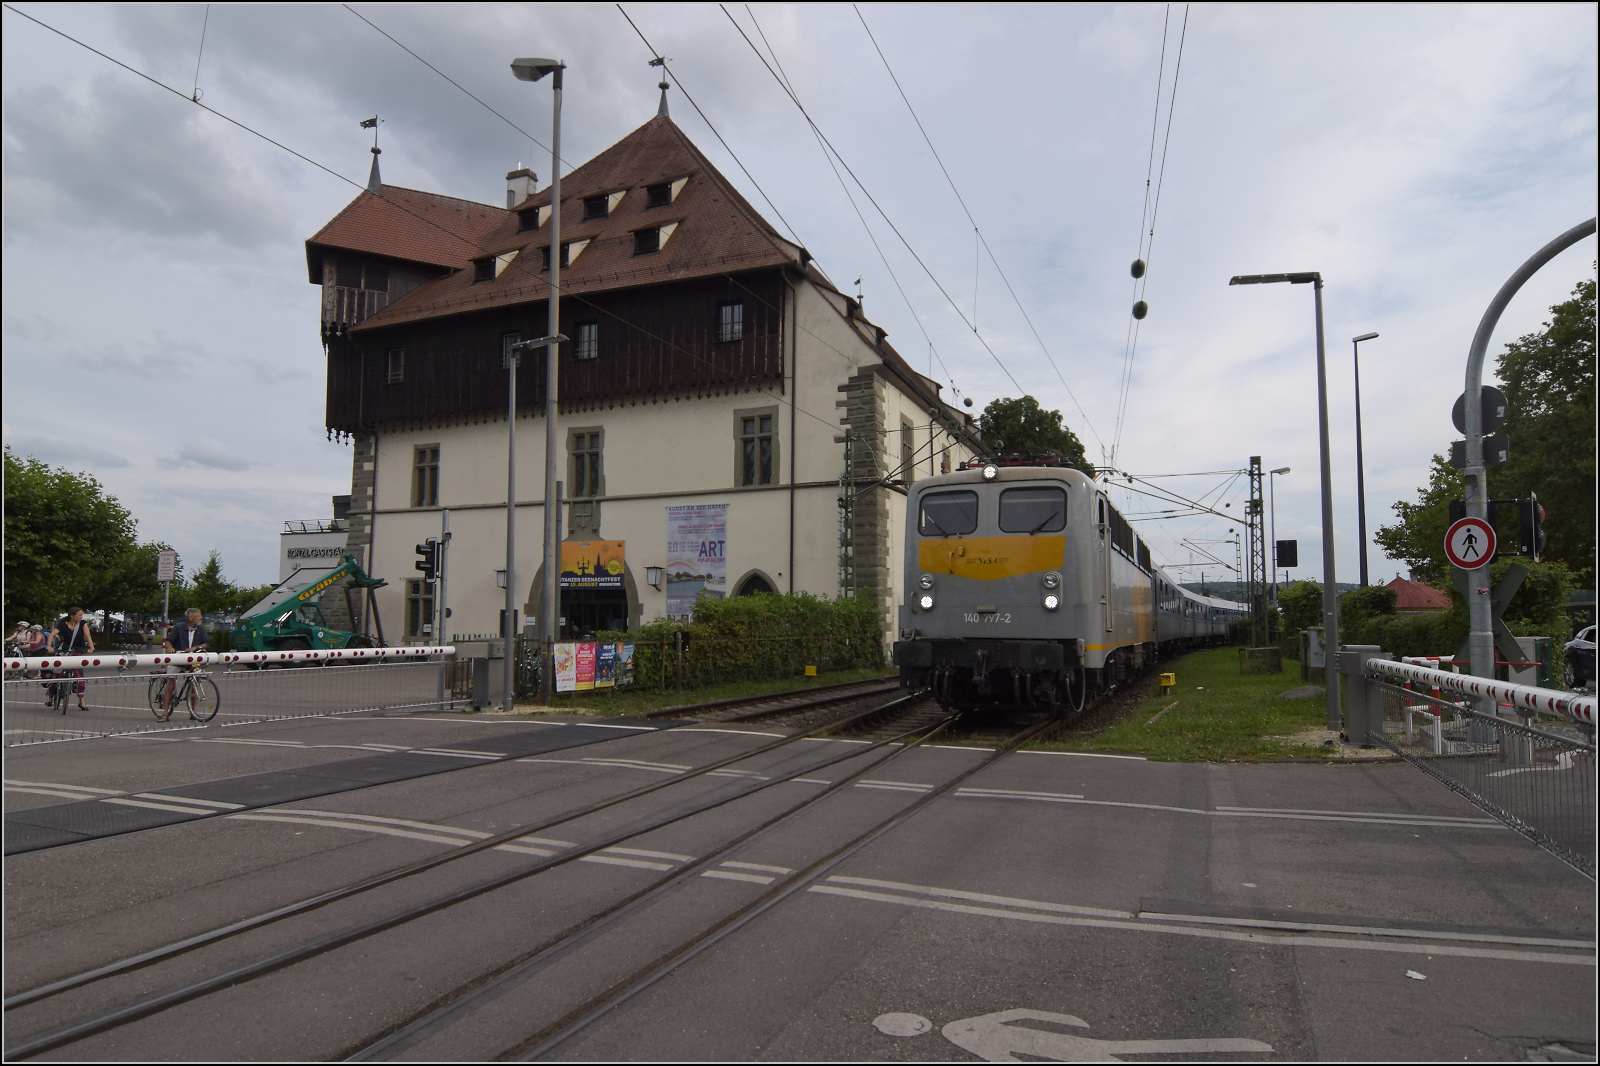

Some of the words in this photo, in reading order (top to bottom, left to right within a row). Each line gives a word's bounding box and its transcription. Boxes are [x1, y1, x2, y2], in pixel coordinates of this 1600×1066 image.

[699, 540, 726, 558] ART
[964, 613, 980, 623] 140
[984, 613, 1011, 623] 797-2
